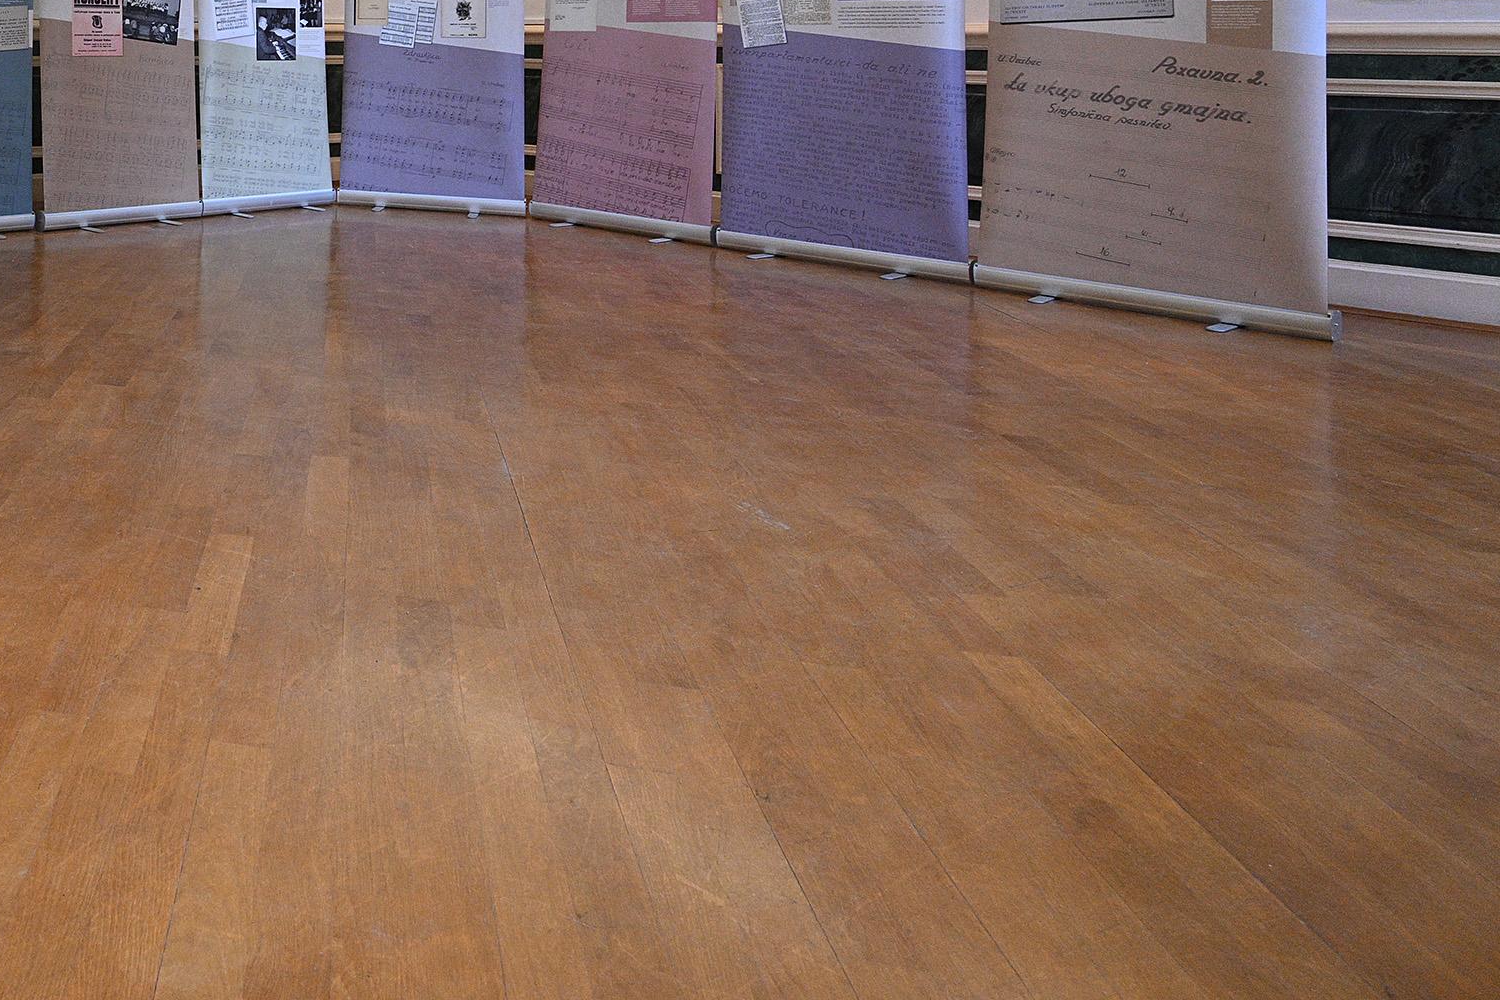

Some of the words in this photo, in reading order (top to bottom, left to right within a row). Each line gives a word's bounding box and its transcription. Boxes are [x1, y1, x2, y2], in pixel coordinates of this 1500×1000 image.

[863, 59, 878, 71] da
[887, 63, 910, 75] ali
[917, 68, 938, 79] ne
[1247, 70, 1268, 86] 2.
[1034, 80, 1081, 102] vkup
[1090, 85, 1152, 111] uboga
[779, 195, 867, 220] TOLERANCE!
